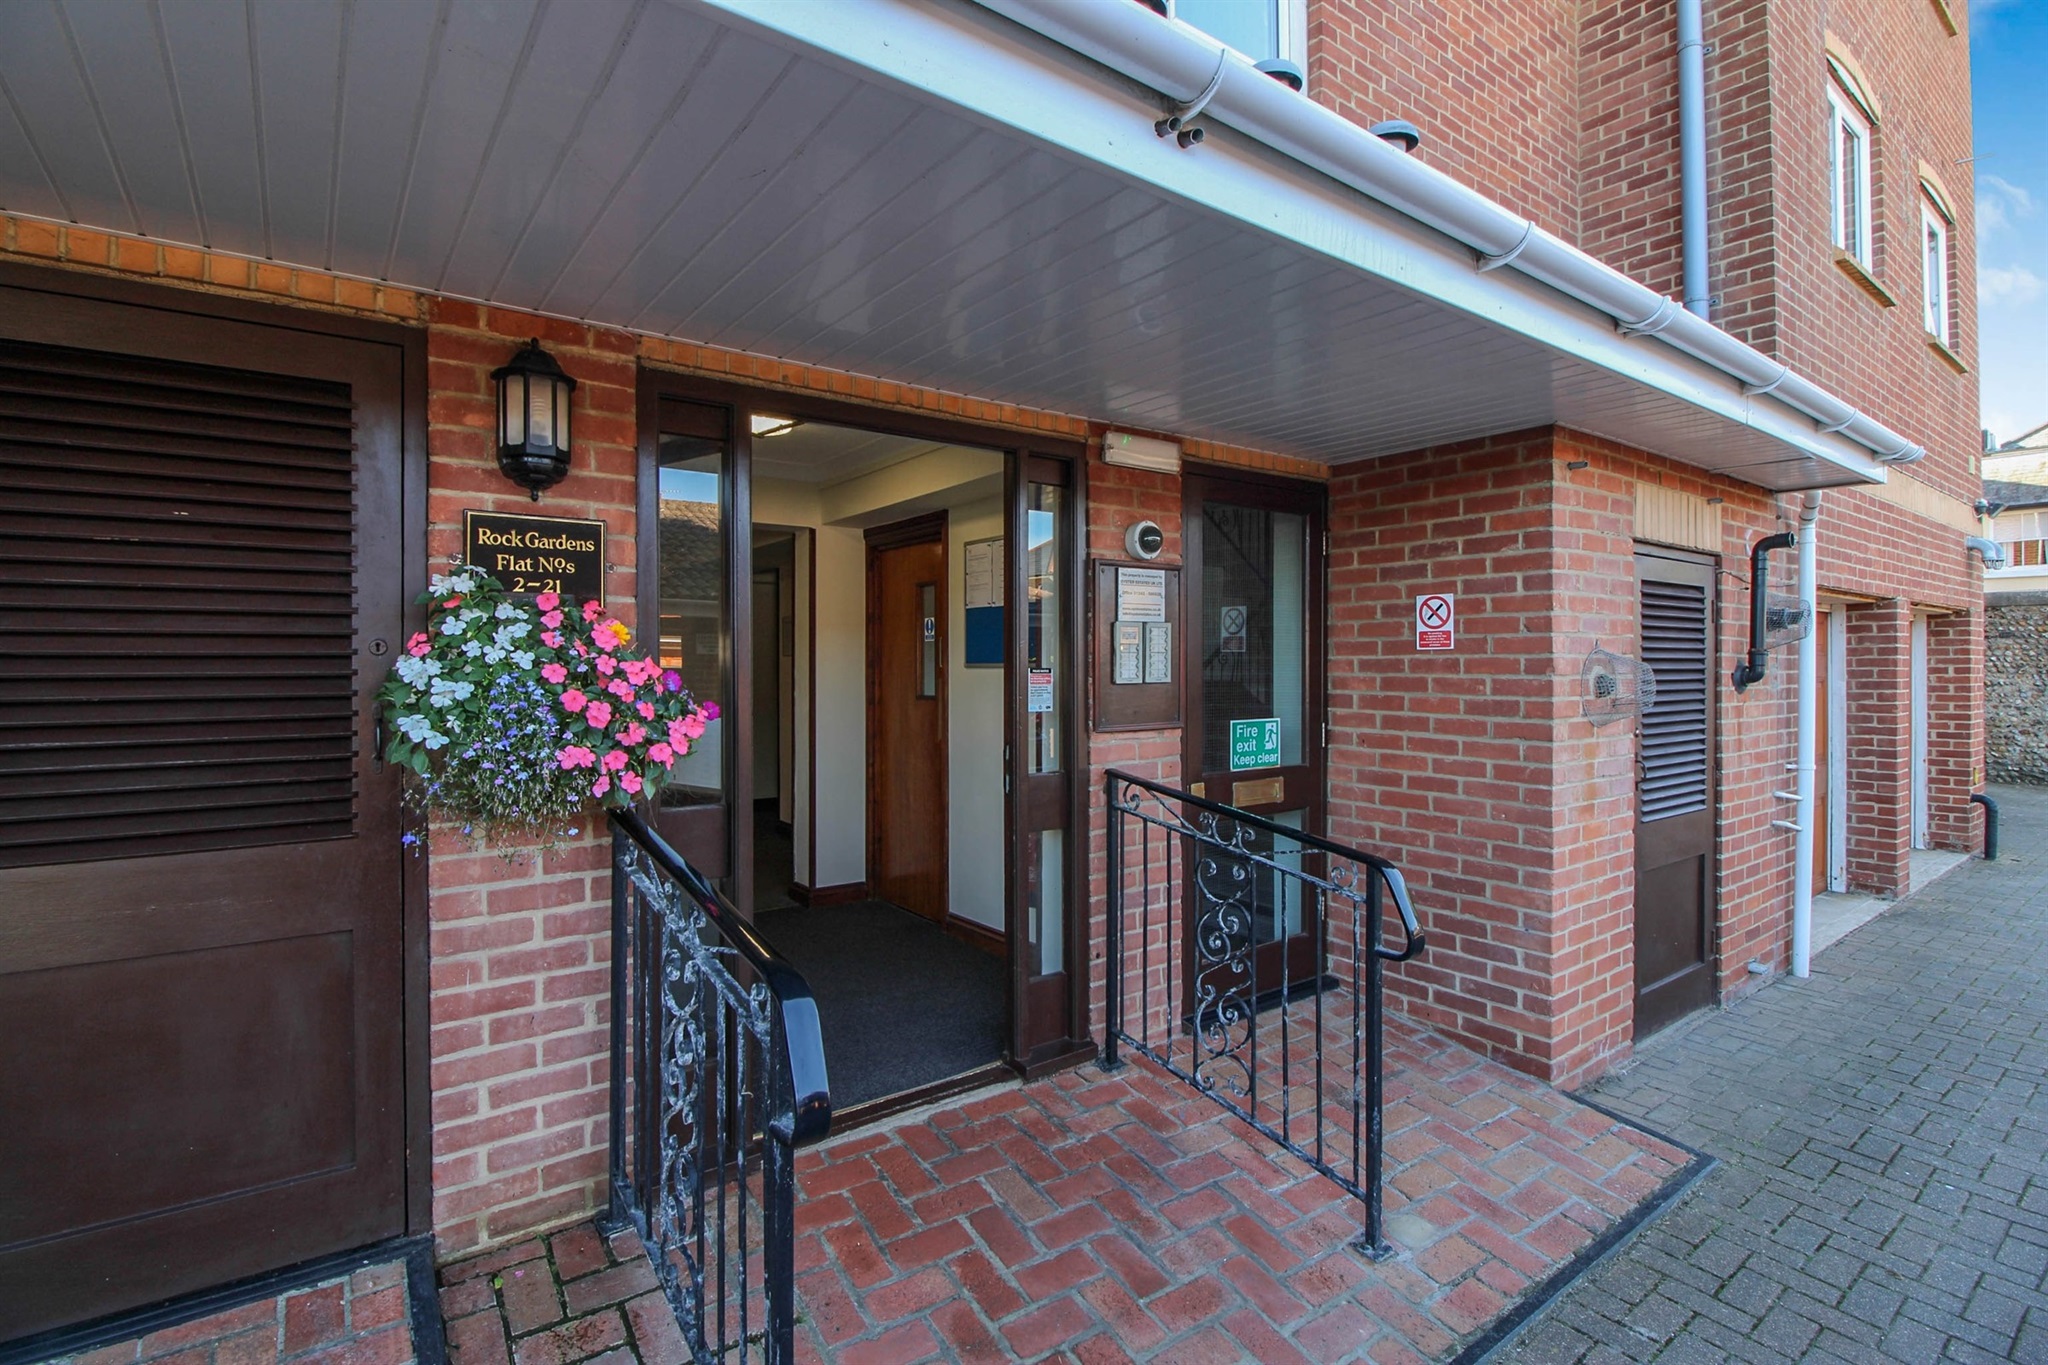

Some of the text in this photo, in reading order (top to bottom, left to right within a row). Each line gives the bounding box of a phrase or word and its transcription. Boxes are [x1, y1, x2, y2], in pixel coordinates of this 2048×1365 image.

[478, 528, 595, 552] Rock Gardens
[496, 554, 534, 572] Flat
[1236, 724, 1258, 738] Fire
[1236, 739, 1257, 752] exit
[1233, 752, 1278, 766] Keep clear
